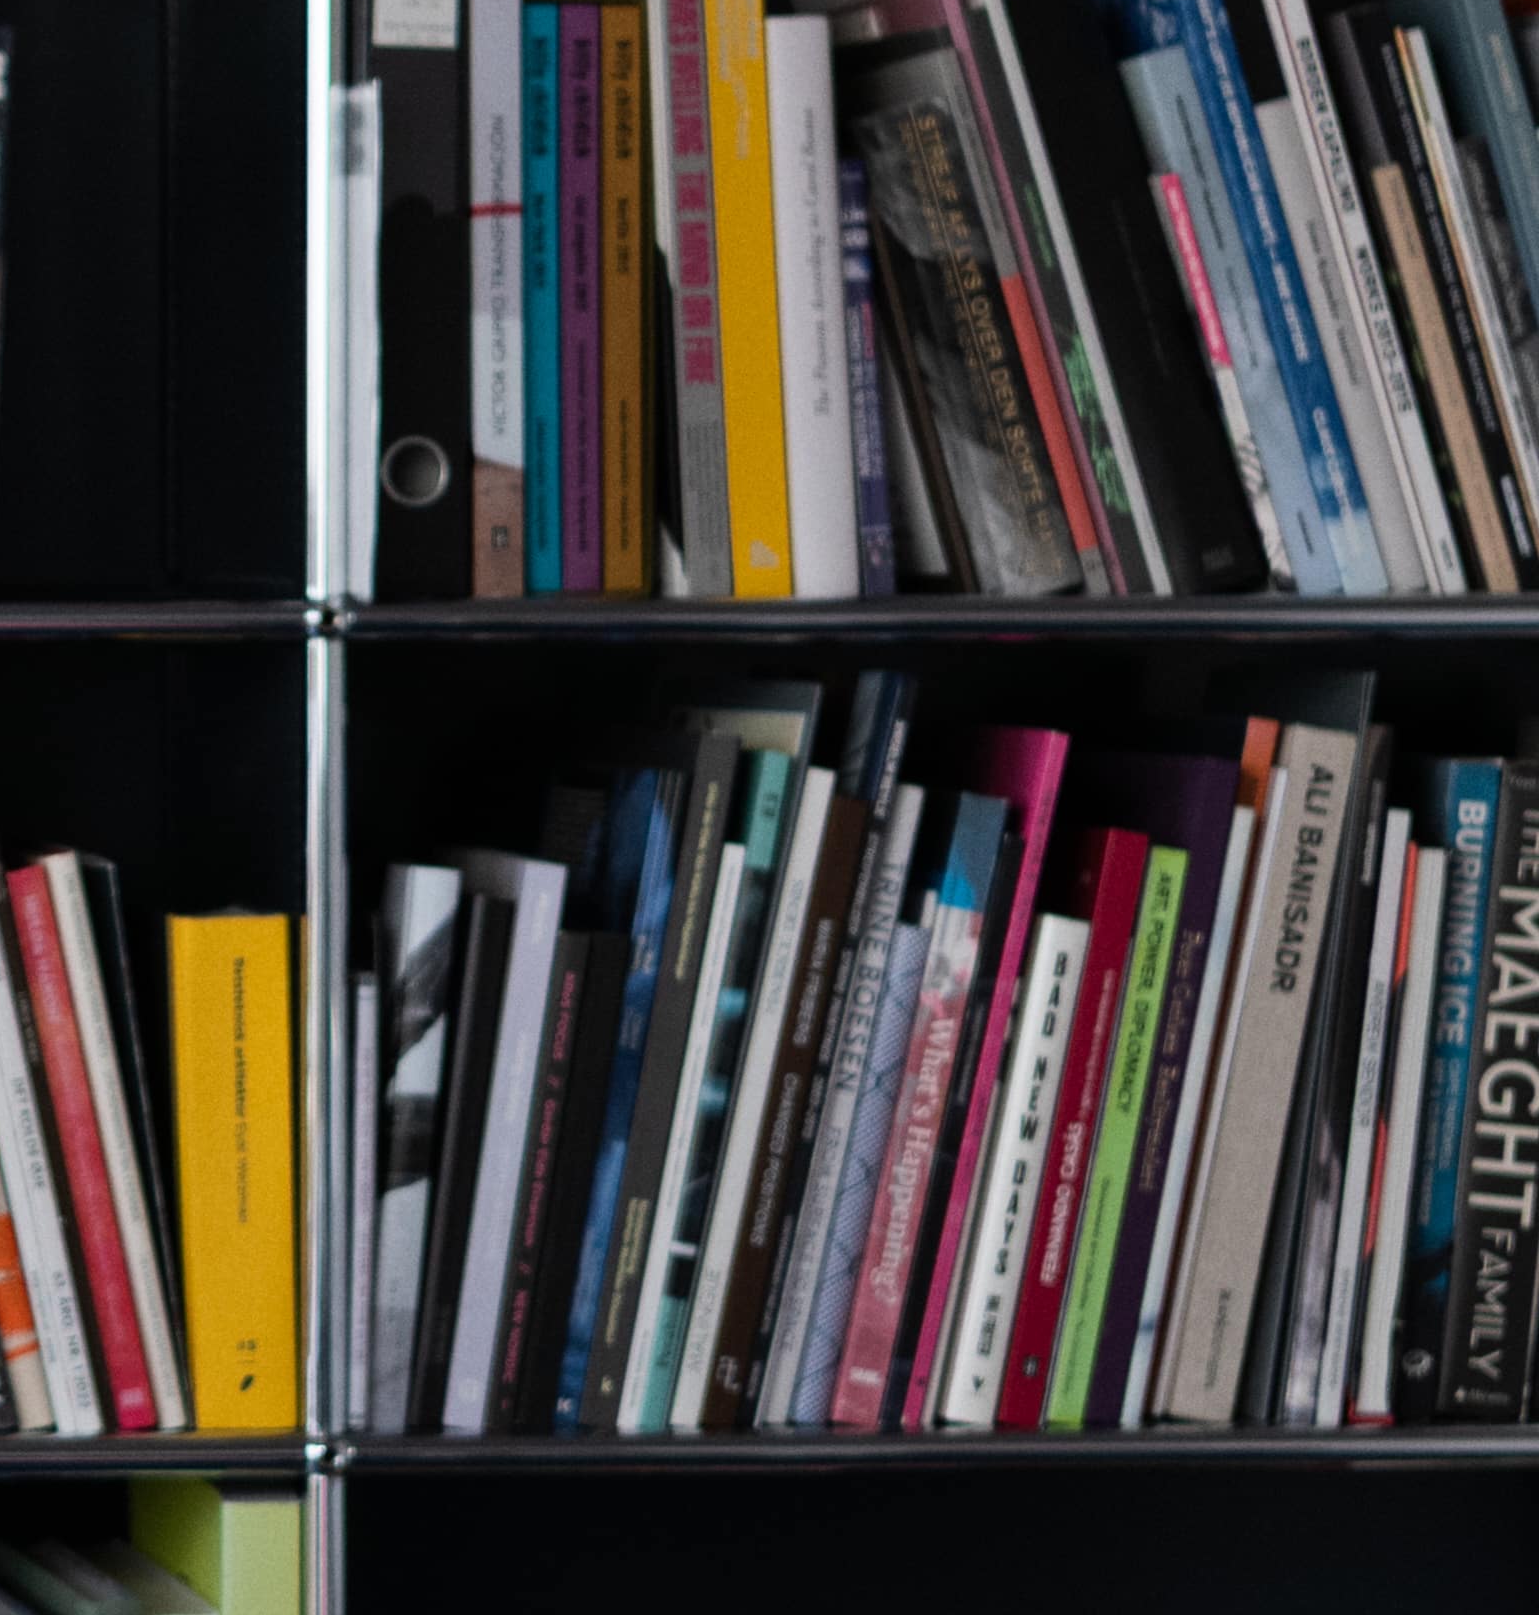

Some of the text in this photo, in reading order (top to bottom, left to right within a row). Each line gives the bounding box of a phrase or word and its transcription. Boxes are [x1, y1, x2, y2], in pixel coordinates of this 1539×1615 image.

[1270, 764, 1334, 994] ALI BANISADR
[1437, 800, 1486, 1043] BURNING ICE
[869, 1018, 957, 1308] What's Happening?
[1468, 886, 1538, 1228] MAEGHT
[1467, 1228, 1514, 1380] FAMILY
